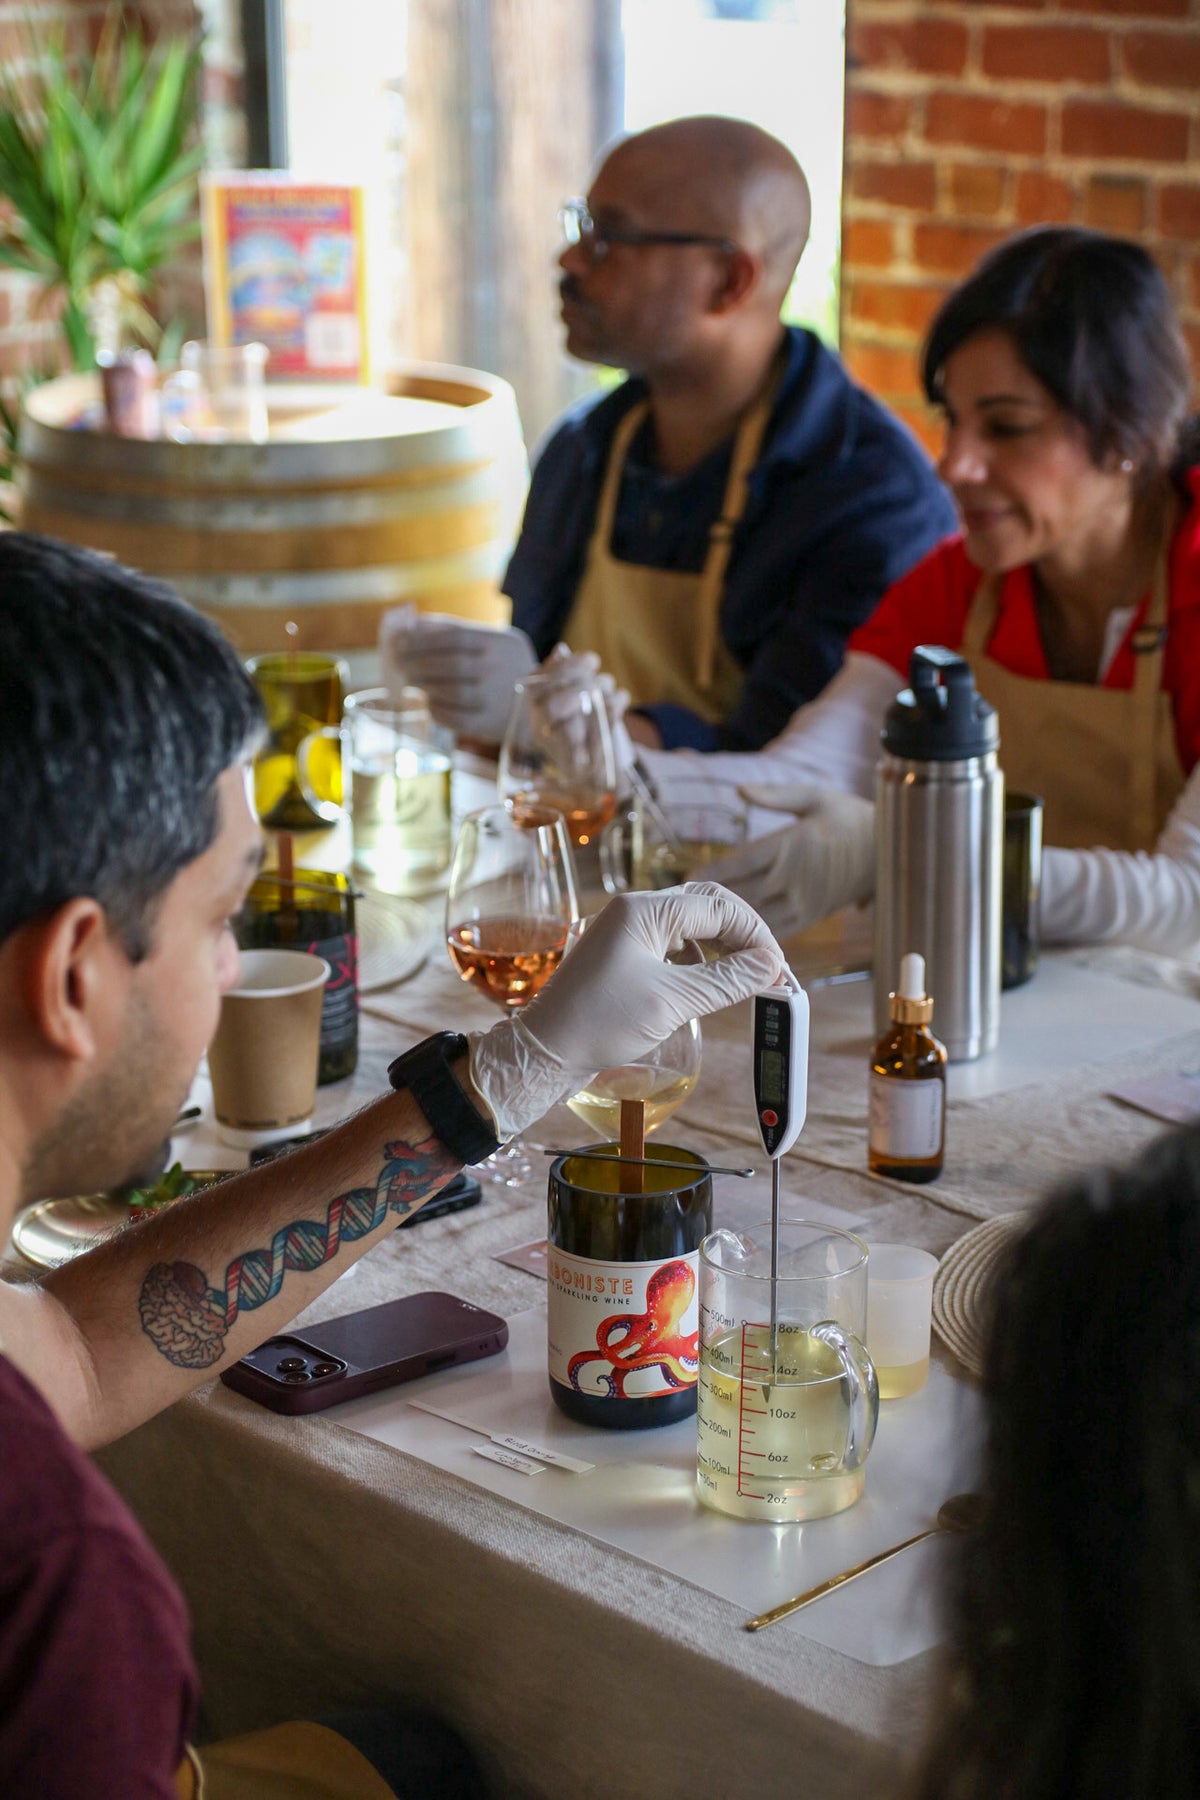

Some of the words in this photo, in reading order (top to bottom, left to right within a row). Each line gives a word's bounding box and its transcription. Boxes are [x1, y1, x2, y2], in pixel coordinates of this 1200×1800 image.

[556, 1283, 599, 1303] SPARKLING
[710, 1310, 735, 1327] 500ml
[772, 1323, 800, 1334] 18oz
[709, 1350, 734, 1366] 400ml
[771, 1365, 798, 1376] 14oz
[708, 1383, 733, 1401] 300ml
[769, 1408, 797, 1419] 10oz
[708, 1420, 732, 1438] 200ml
[708, 1457, 730, 1475] 100ml
[767, 1453, 789, 1463] 6oz
[767, 1493, 788, 1504] 2oz
